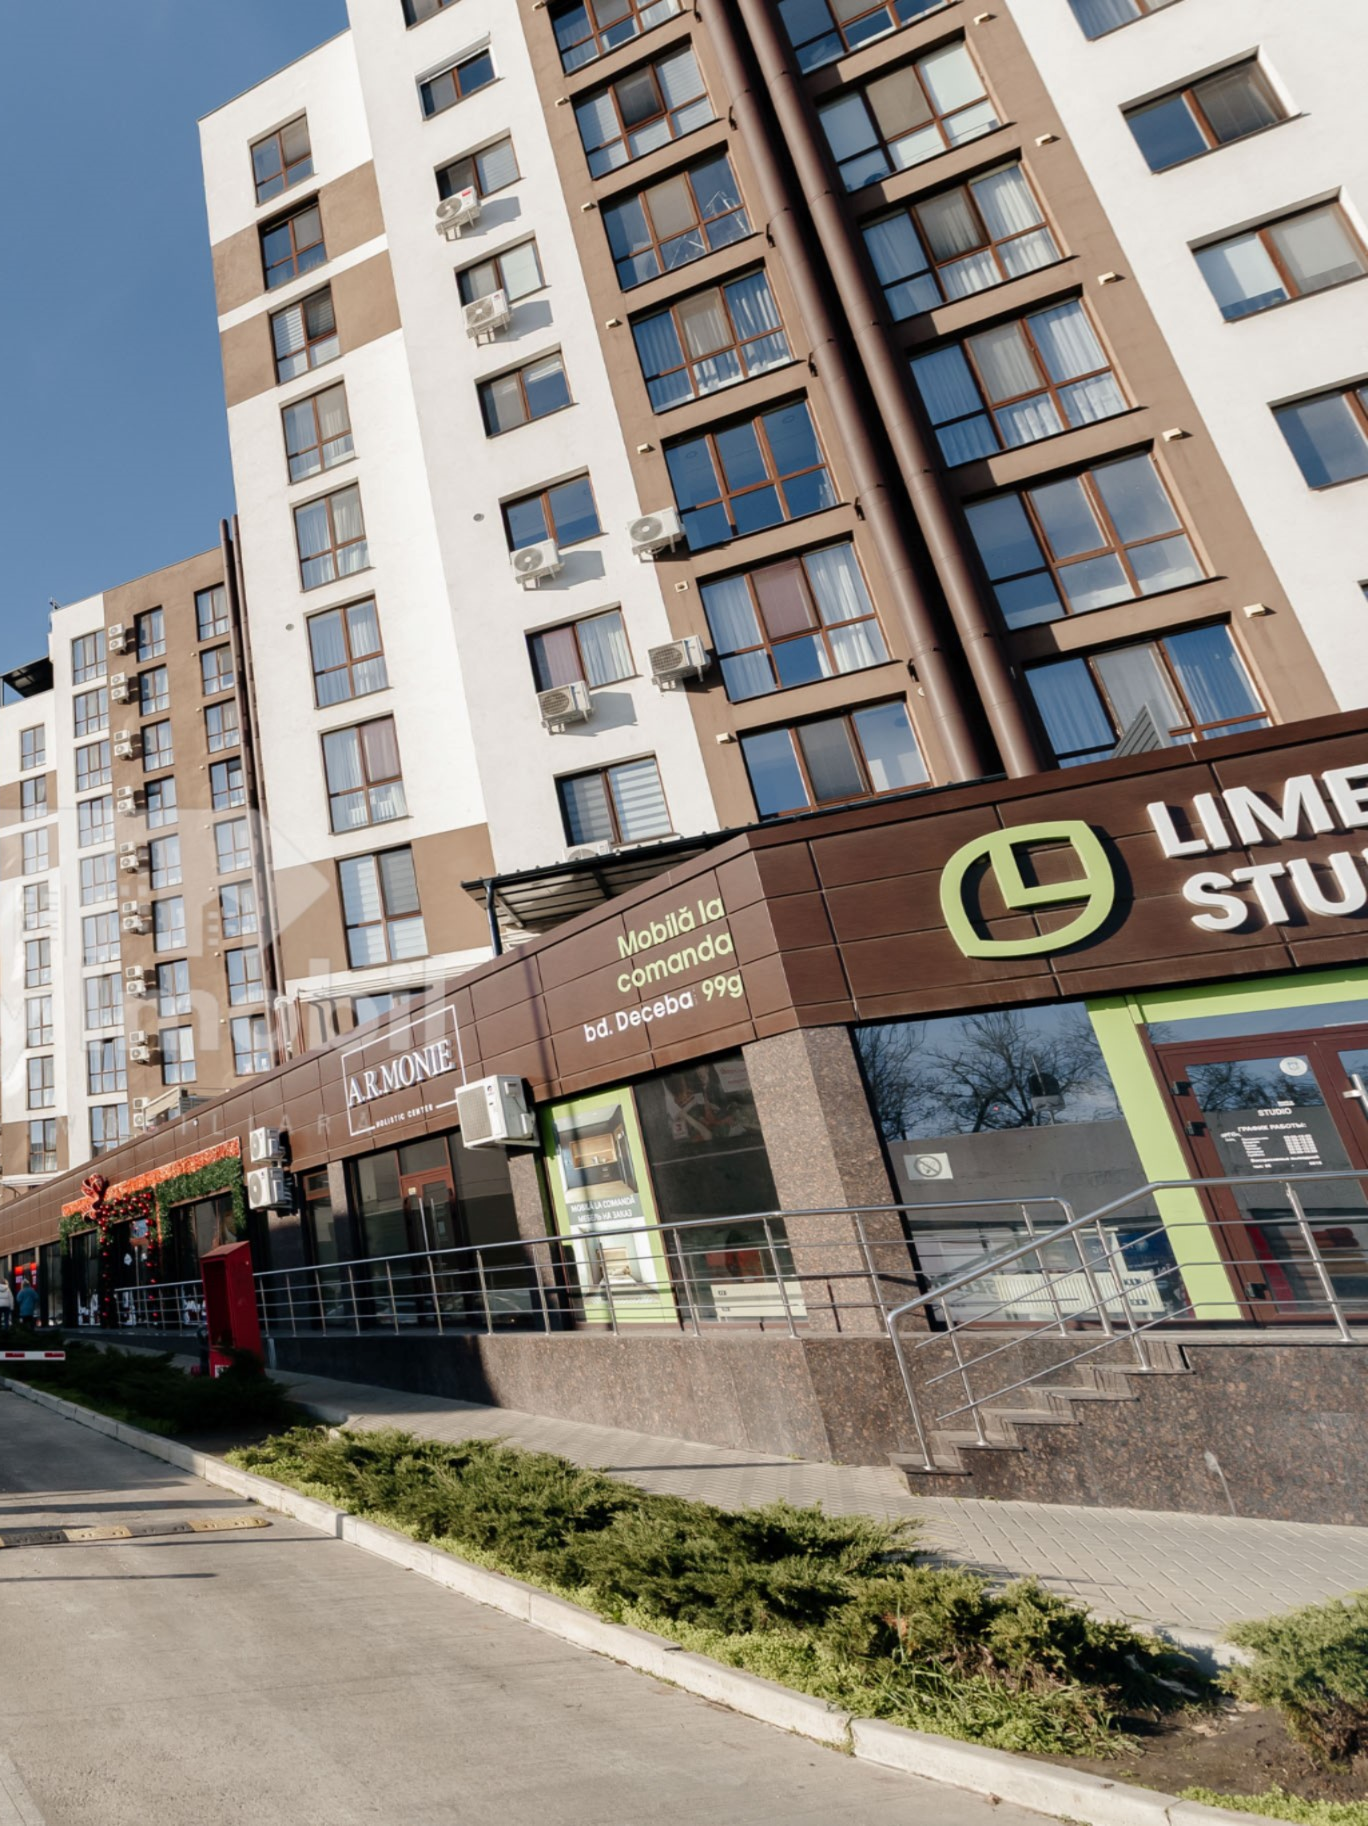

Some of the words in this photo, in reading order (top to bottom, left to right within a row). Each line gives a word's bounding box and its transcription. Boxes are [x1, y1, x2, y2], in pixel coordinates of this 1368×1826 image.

[1147, 763, 1368, 859] LIME
[1182, 848, 1368, 932] STU
[617, 906, 695, 959] Mobilă
[697, 897, 726, 924] la
[617, 932, 734, 993] comanda
[583, 1017, 614, 1042] bd.
[701, 974, 744, 1002] 99g
[376, 1113, 405, 1129] HOLISTIC
[407, 1103, 434, 1119] CENTER
[1257, 1108, 1292, 1117] STUDIO
[594, 1201, 602, 1210] LA
[602, 1212, 612, 1220] НА
[612, 1209, 632, 1219] ЗАКАЗ
